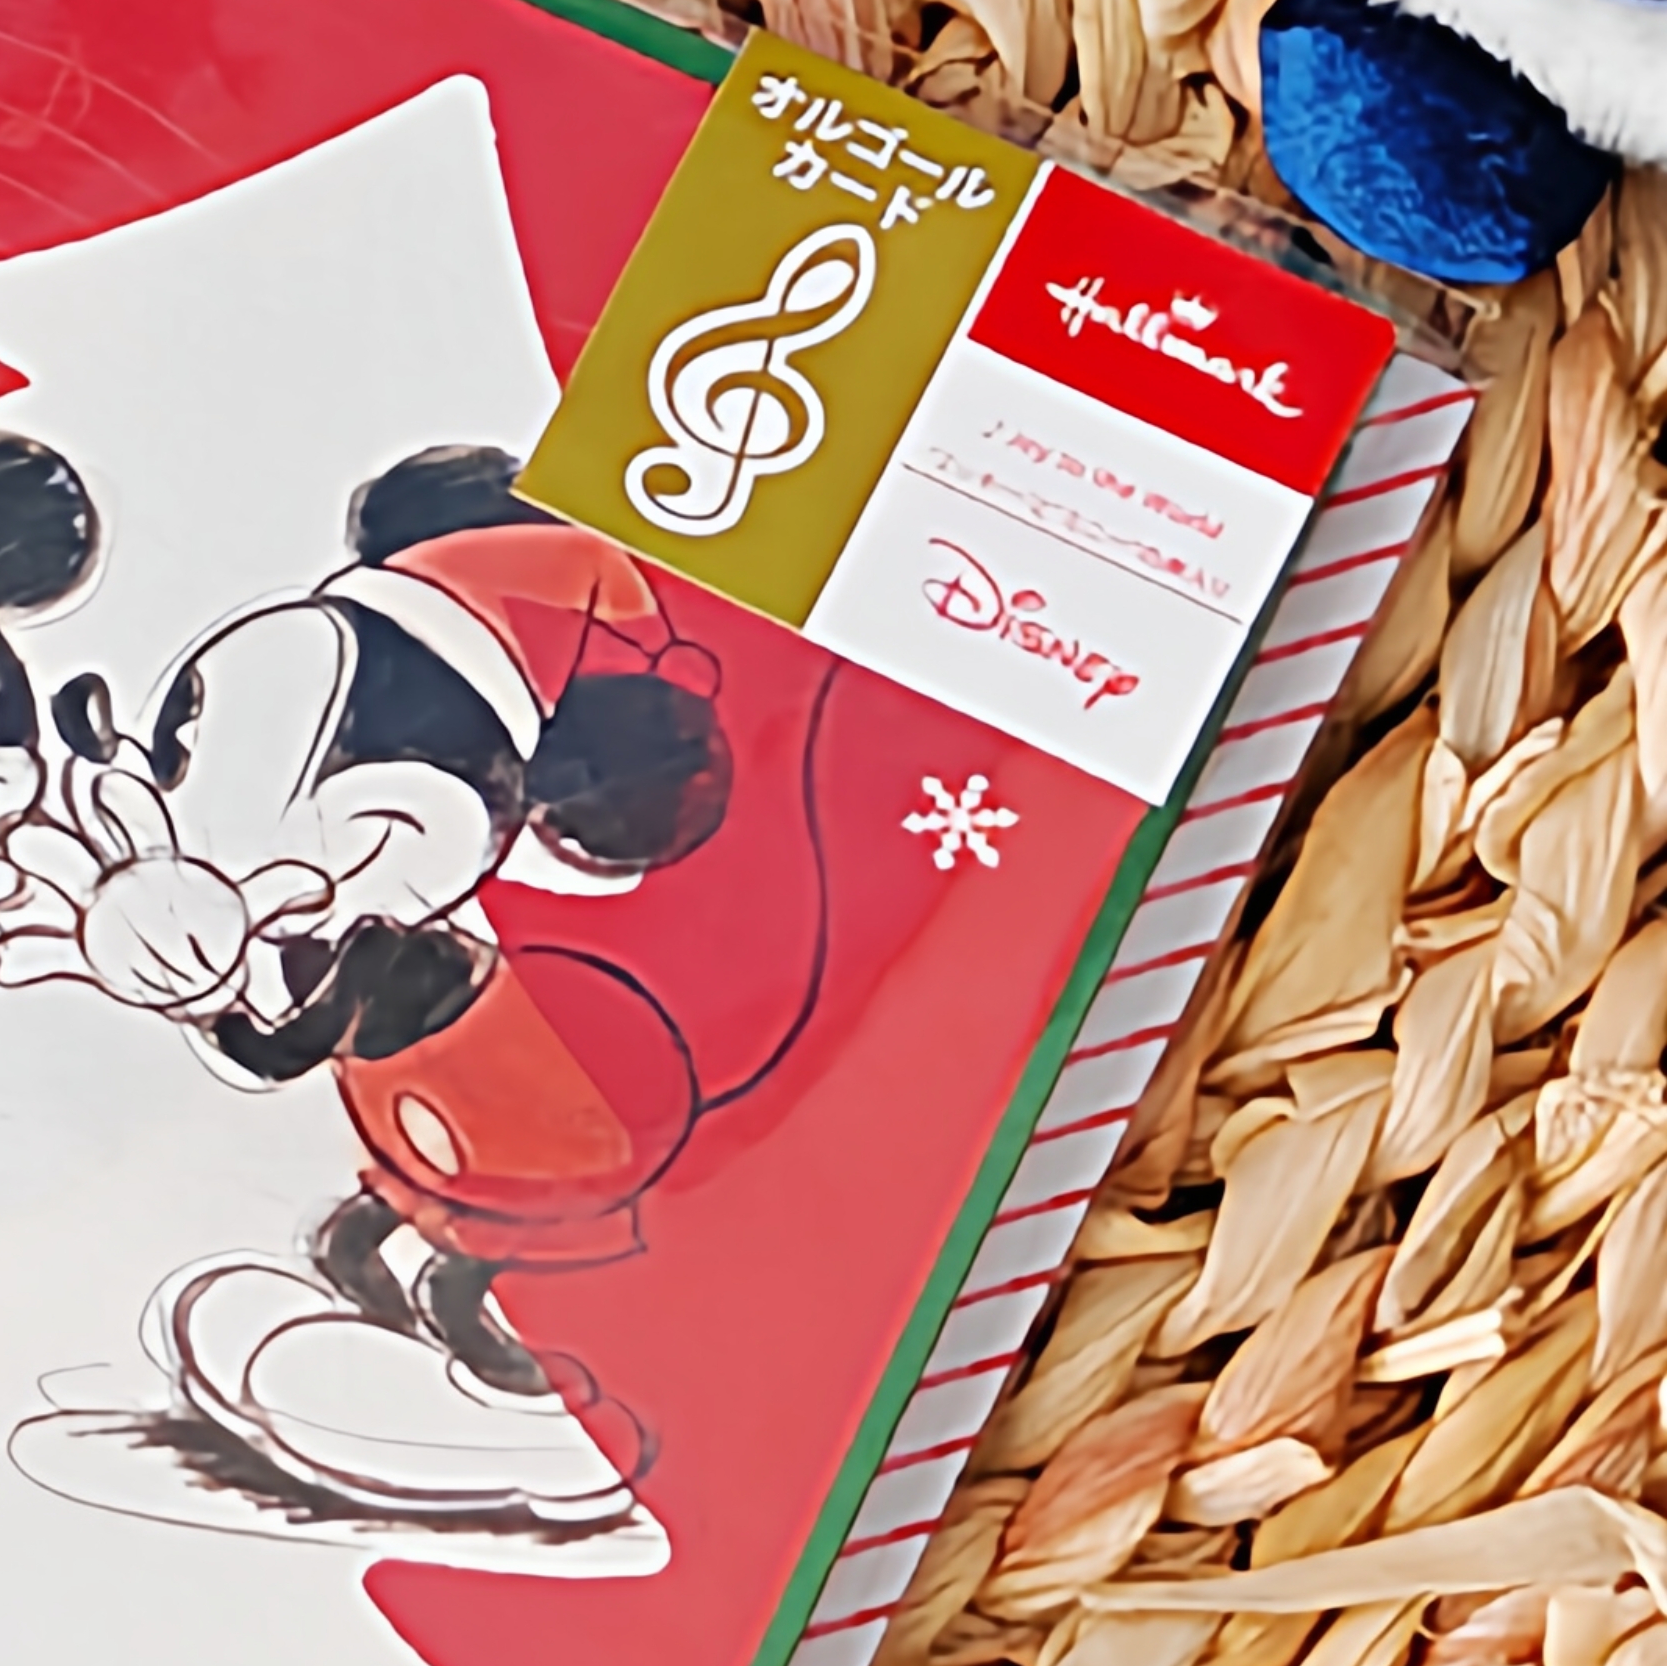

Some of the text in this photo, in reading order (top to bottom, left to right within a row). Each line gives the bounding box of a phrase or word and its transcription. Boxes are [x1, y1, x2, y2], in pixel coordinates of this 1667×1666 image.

[751, 73, 997, 210] オルゴール
[772, 141, 934, 230] カード
[1046, 276, 1304, 419] Hallmark
